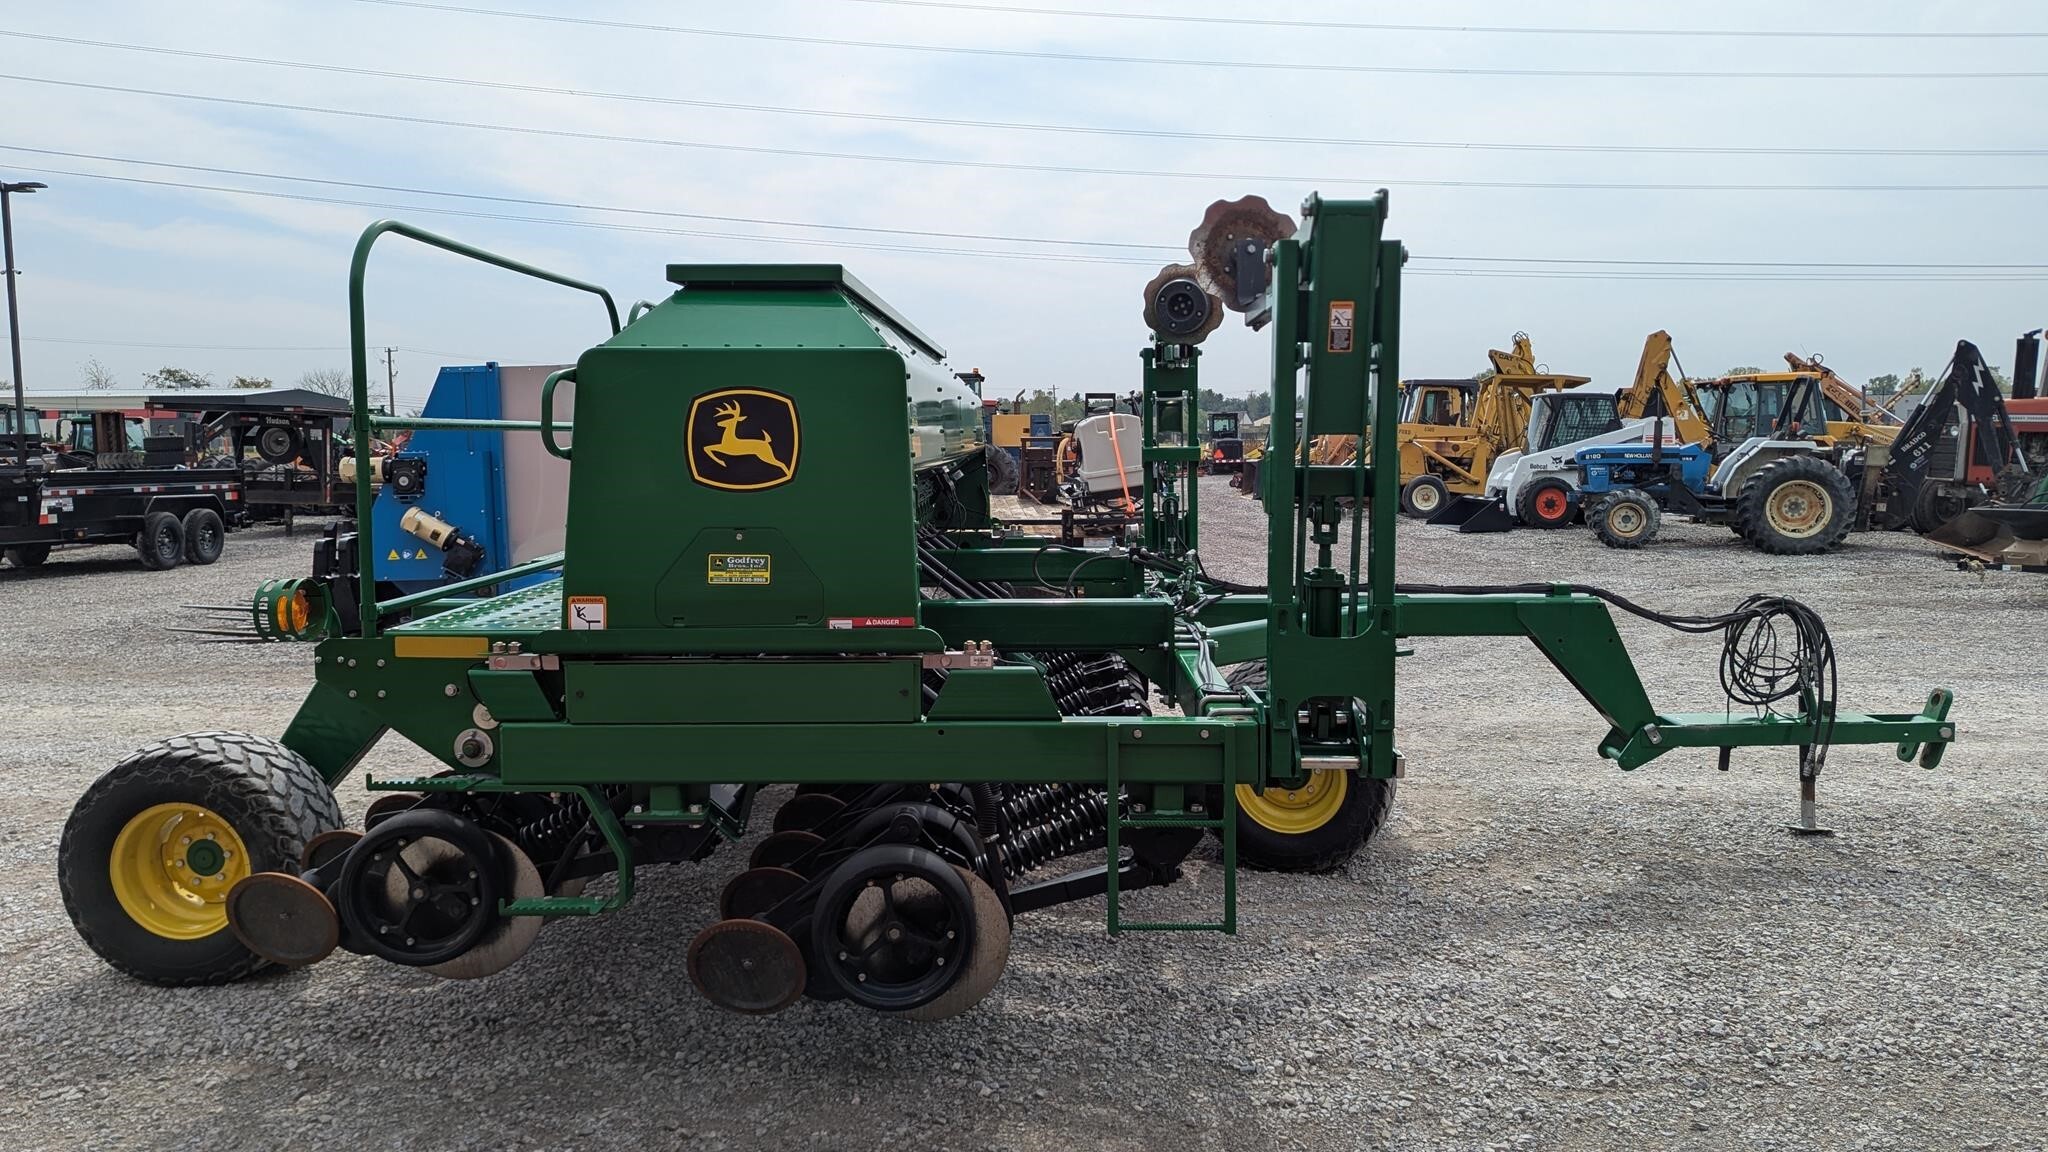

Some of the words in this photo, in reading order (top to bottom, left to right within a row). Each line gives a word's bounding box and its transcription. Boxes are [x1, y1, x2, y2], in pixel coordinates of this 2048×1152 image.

[266, 416, 290, 425] Hudson
[1901, 431, 1926, 452] BRADCO
[1913, 442, 1932, 457] 611
[727, 556, 766, 565] Godfrey
